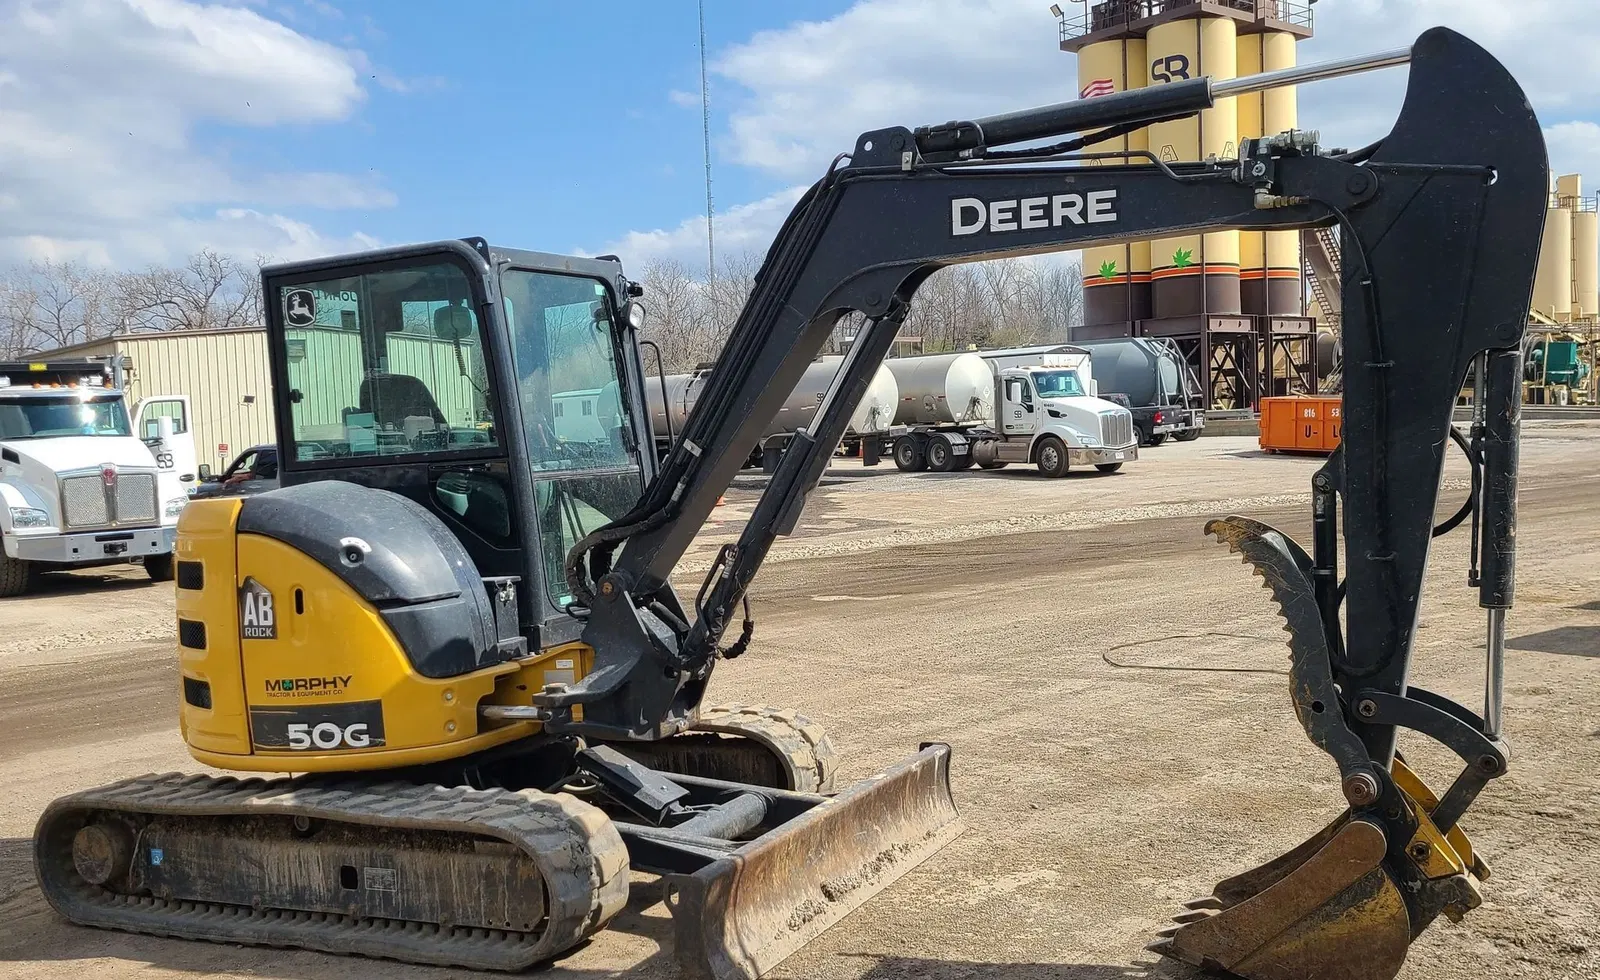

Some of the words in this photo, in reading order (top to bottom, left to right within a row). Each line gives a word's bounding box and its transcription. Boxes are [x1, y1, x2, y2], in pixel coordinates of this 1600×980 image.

[951, 189, 1117, 236] DEERE
[1304, 408, 1316, 417] 816
[244, 592, 274, 626] AB
[245, 627, 273, 637] ROCK
[265, 675, 353, 692] MURPHY
[297, 690, 332, 698] EQUIPMENT
[287, 722, 370, 750] 50G
